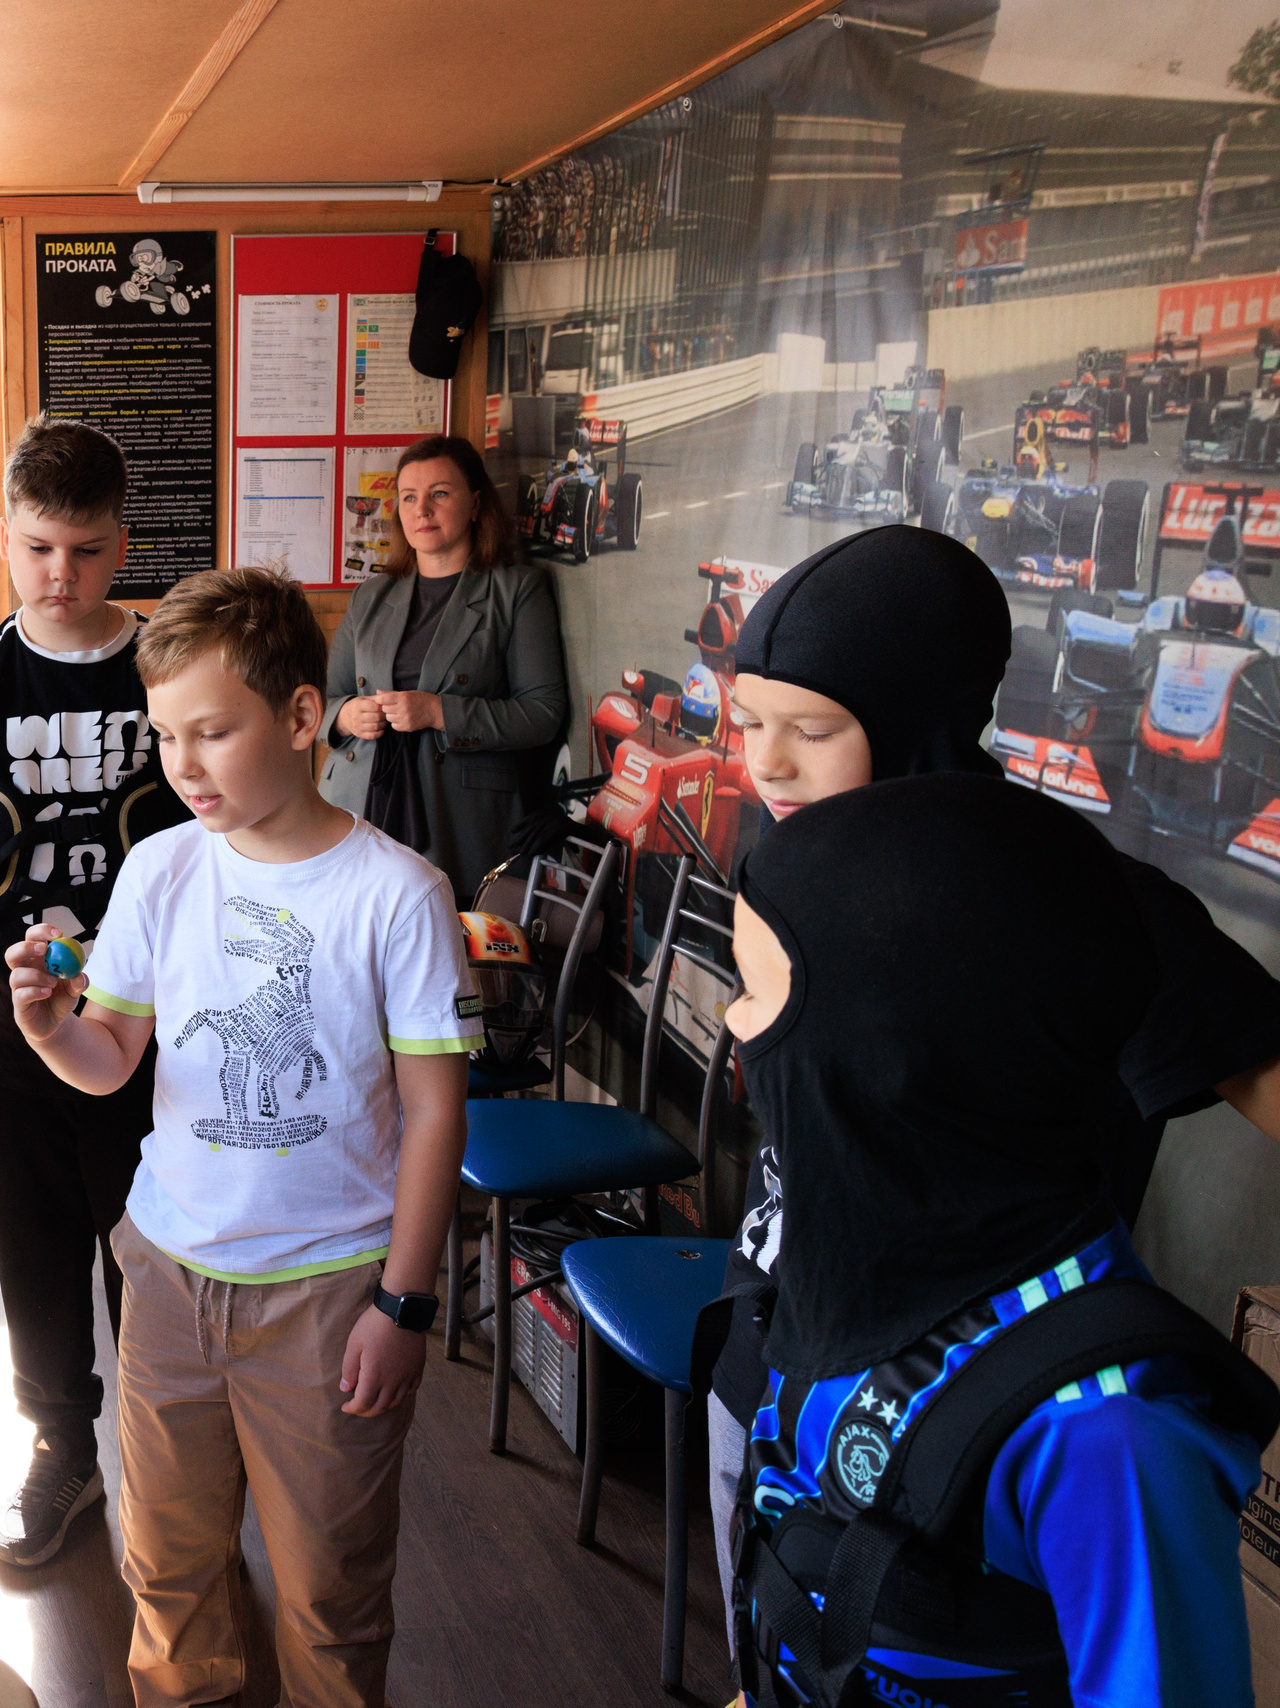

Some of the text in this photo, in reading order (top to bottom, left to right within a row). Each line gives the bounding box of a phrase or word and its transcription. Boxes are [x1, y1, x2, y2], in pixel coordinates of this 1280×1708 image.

[45, 242, 116, 255] ПРАВИЛА
[46, 259, 116, 273] ПРОКАТА
[6, 711, 102, 759] WE
[620, 753, 652, 785] 5
[235, 907, 265, 921] DISCOVER
[276, 963, 309, 981] t-rex
[562, 1315, 571, 1331] 195
[839, 1424, 871, 1447] AJAX
